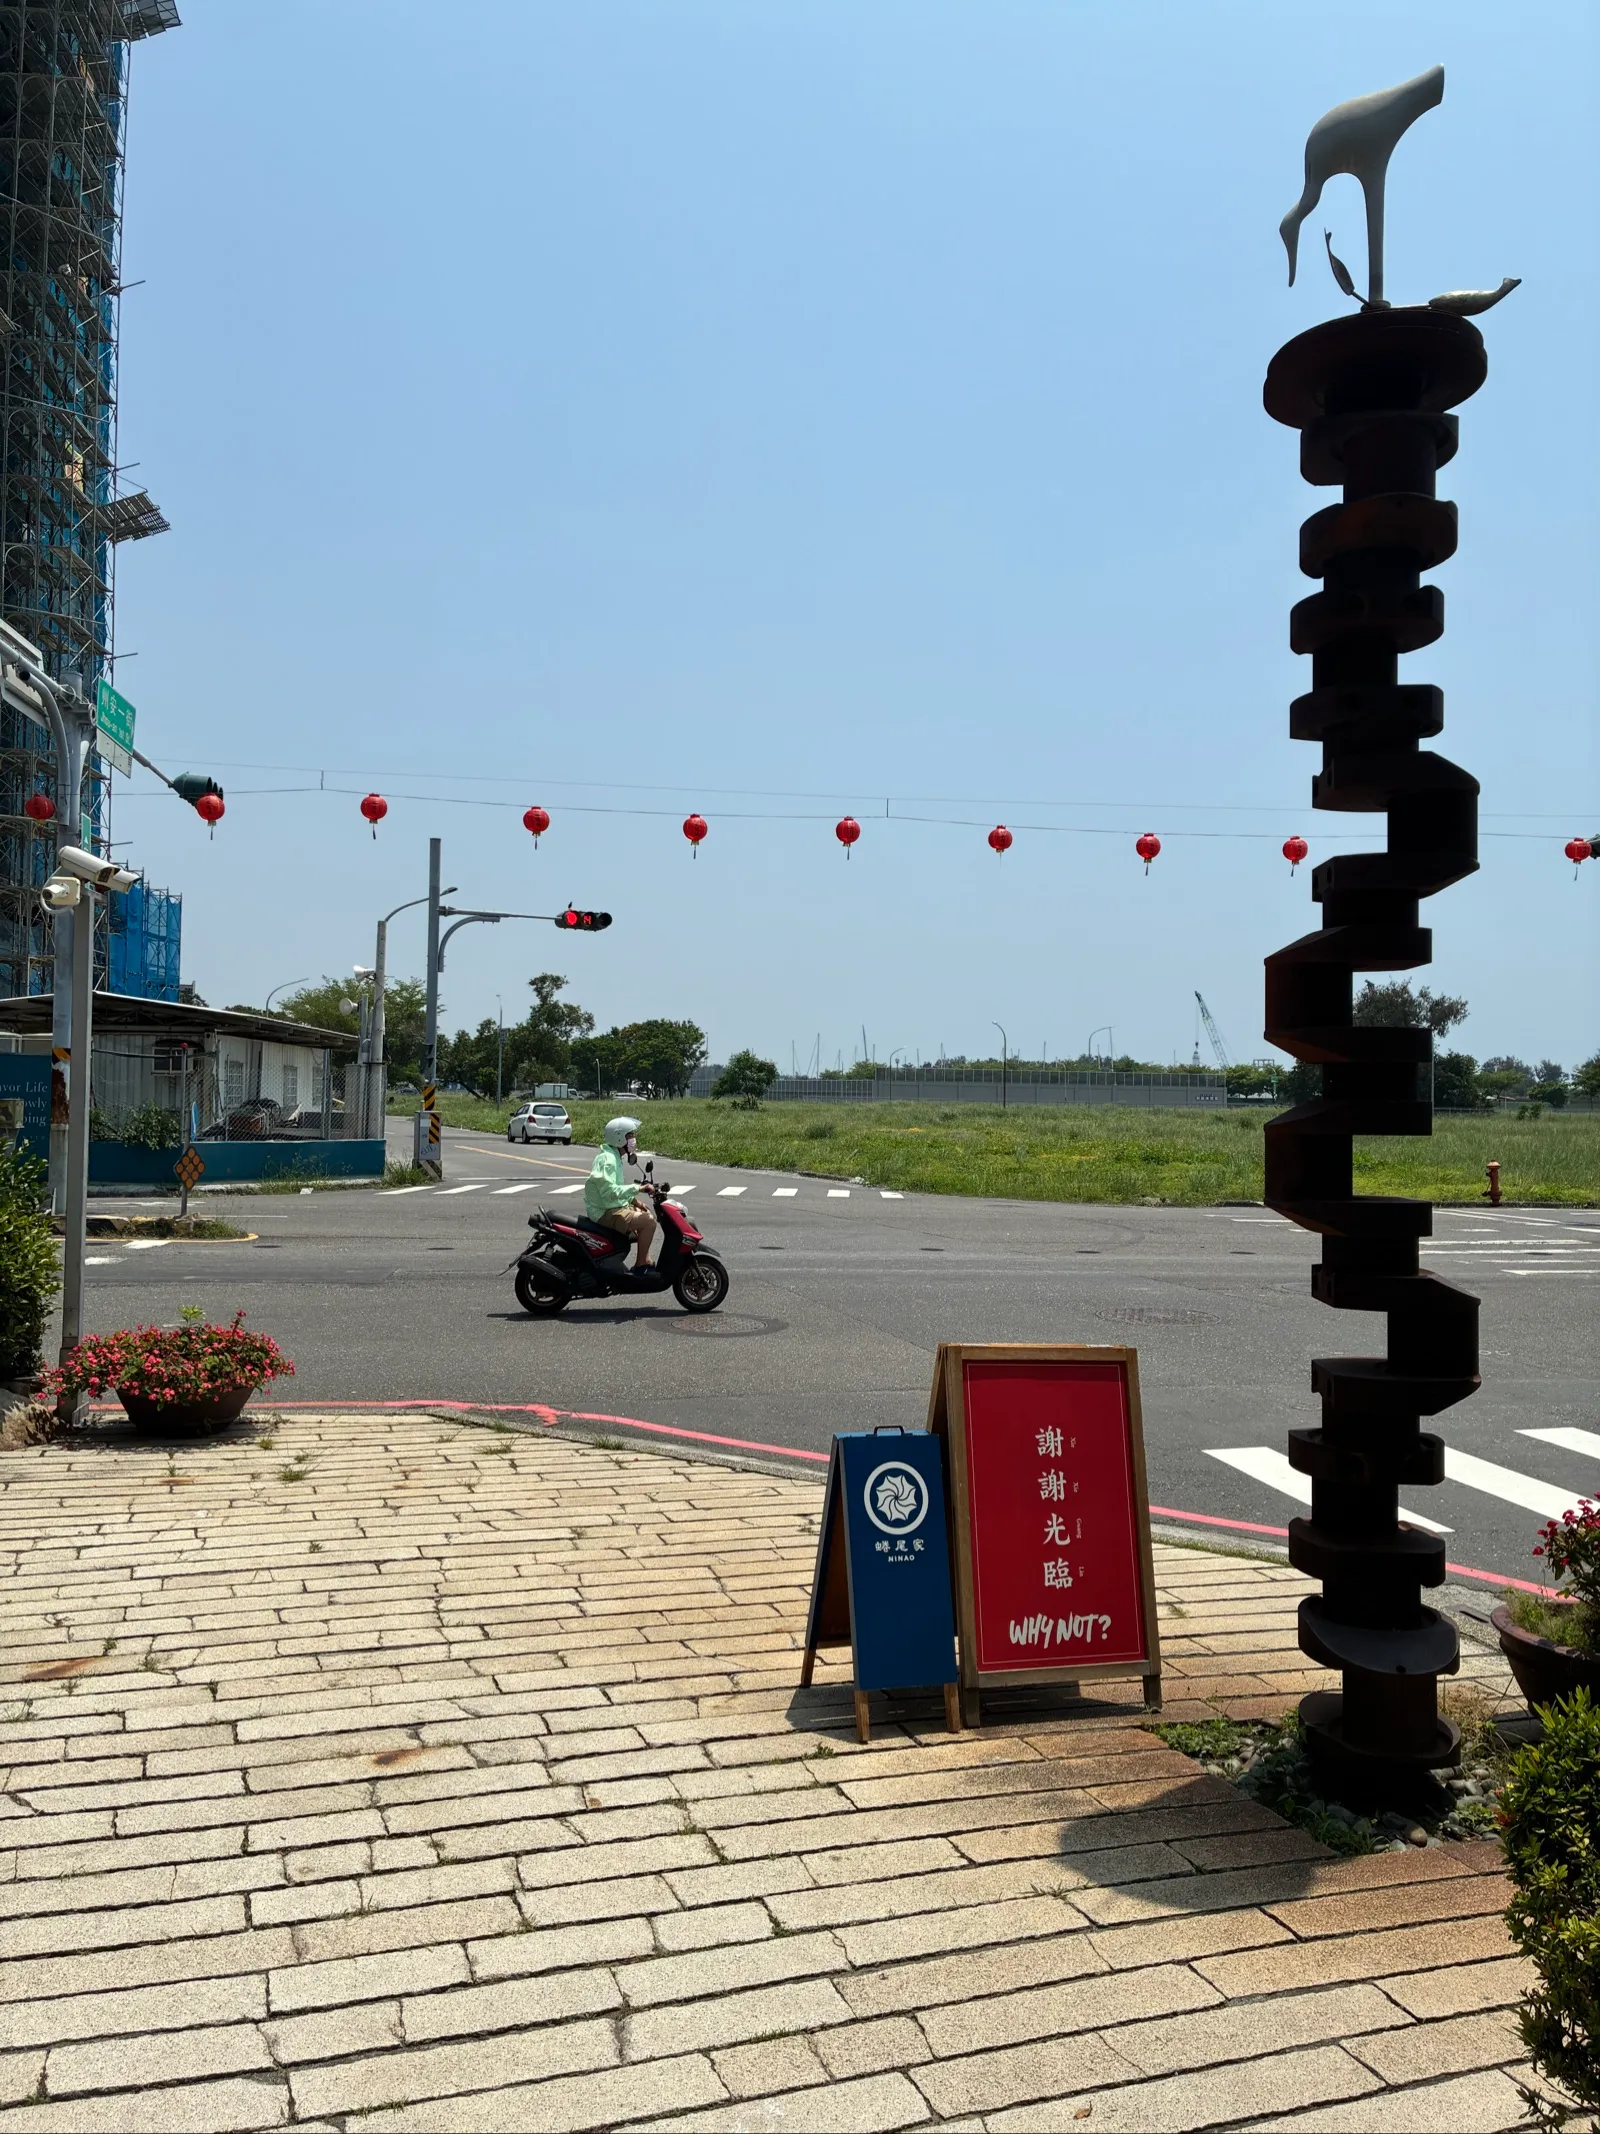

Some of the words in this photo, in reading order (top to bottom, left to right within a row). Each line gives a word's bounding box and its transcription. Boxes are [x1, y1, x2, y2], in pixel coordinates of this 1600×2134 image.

[26, 1081, 48, 1093] Life
[1034, 1424, 1074, 1590] 謝謝光臨
[887, 1554, 916, 1563] NINAO
[1009, 1612, 1055, 1650] WHY
[1056, 1611, 1112, 1645] NOT?
